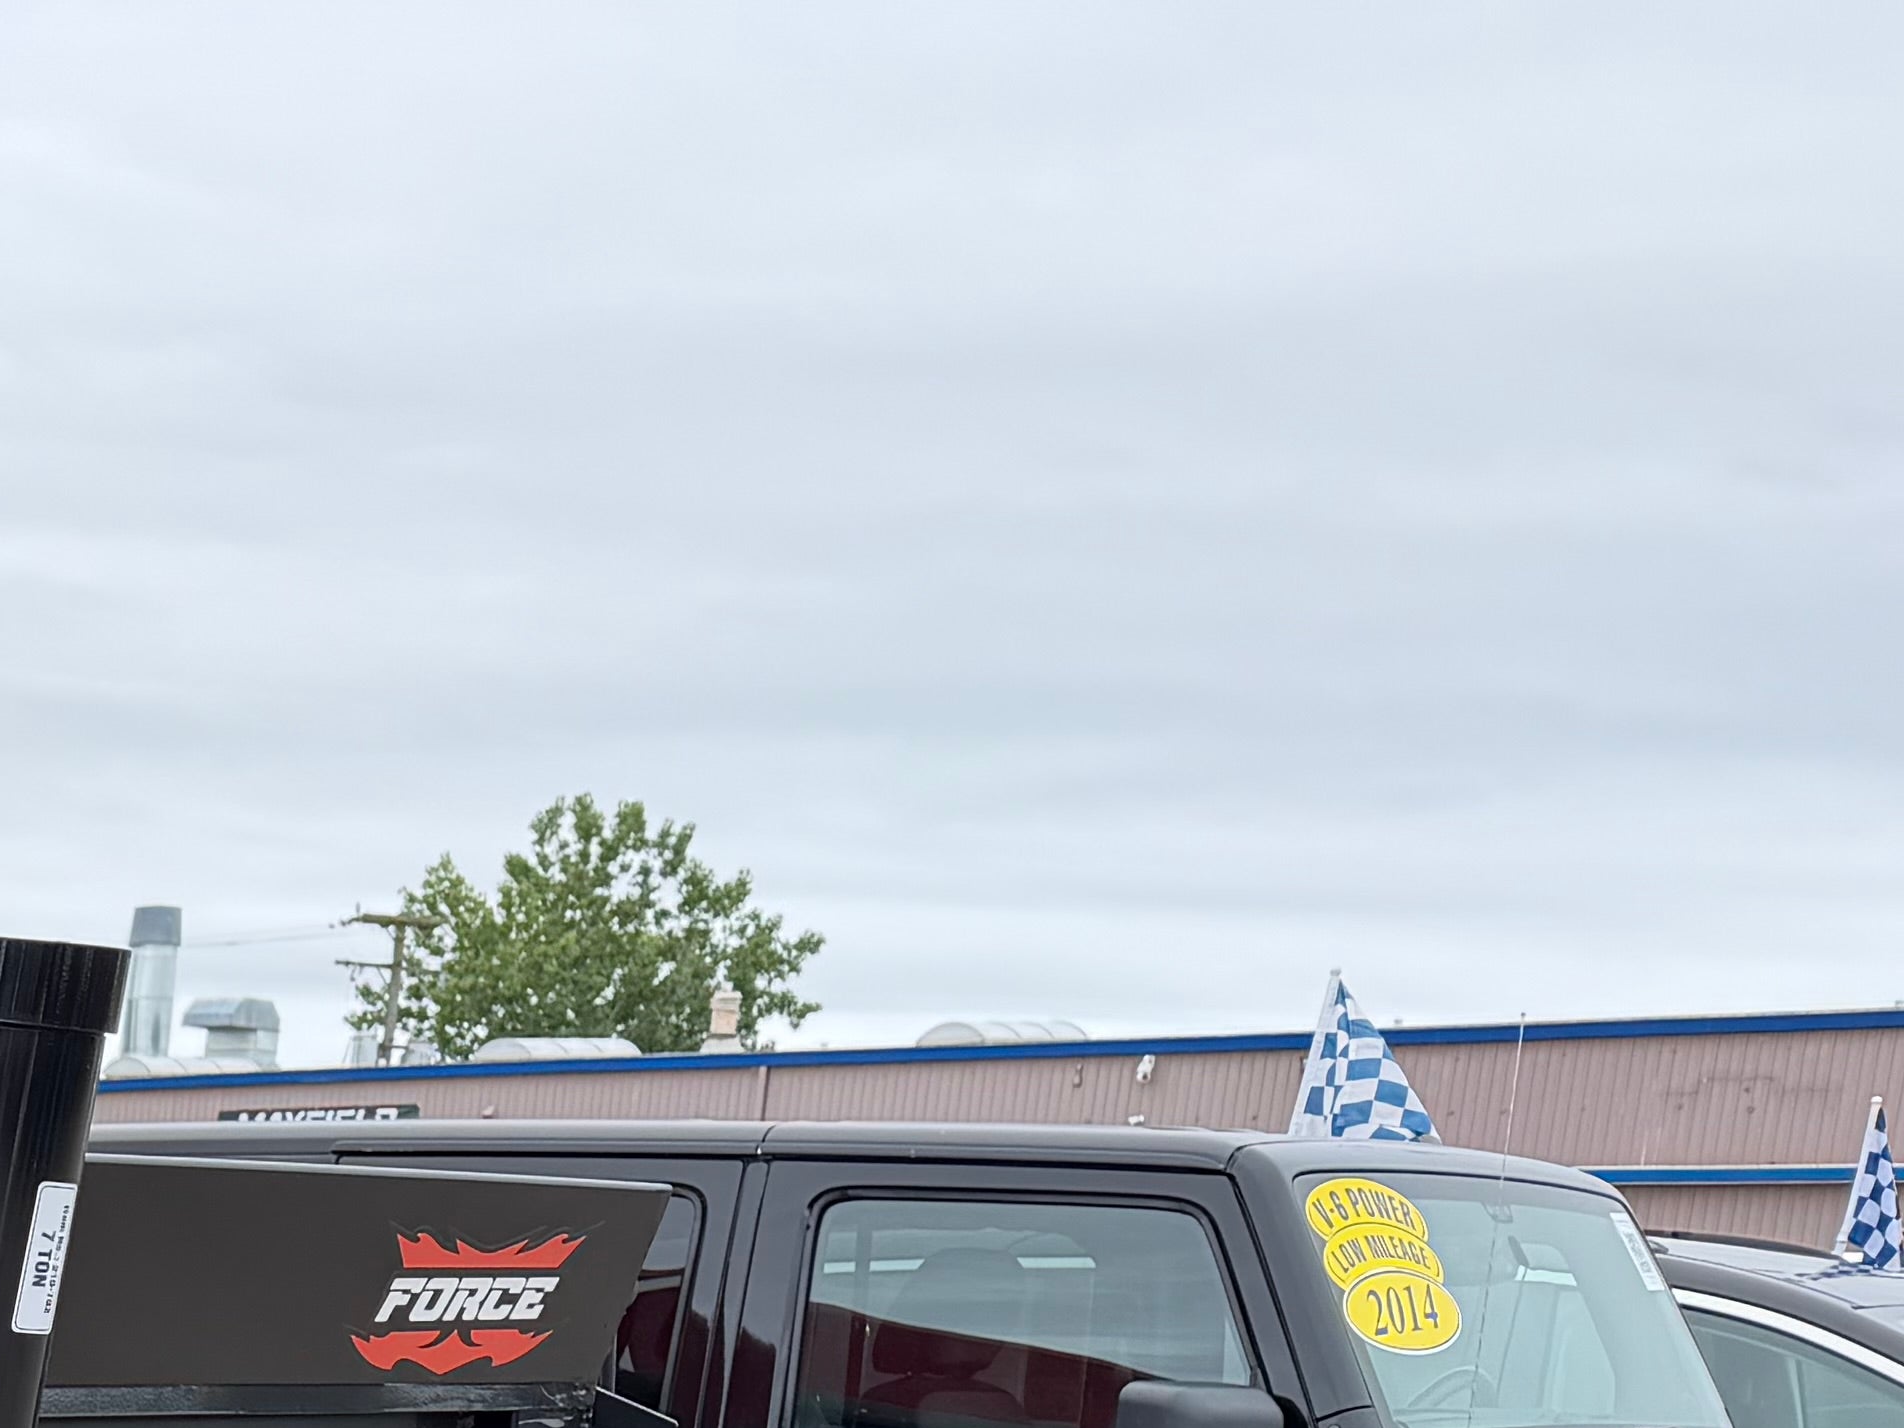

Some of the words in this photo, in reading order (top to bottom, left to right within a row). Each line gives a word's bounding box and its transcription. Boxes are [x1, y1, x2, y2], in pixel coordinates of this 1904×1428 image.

[1311, 1189, 1350, 1229] V-6
[1345, 1187, 1418, 1231] POWER
[41, 1231, 56, 1242] 7
[1331, 1236, 1367, 1274] LOW
[1364, 1235, 1432, 1270] MILEAGE
[32, 1248, 53, 1288] TON
[374, 1276, 560, 1322] FORCE
[1366, 1284, 1439, 1336] 2014
